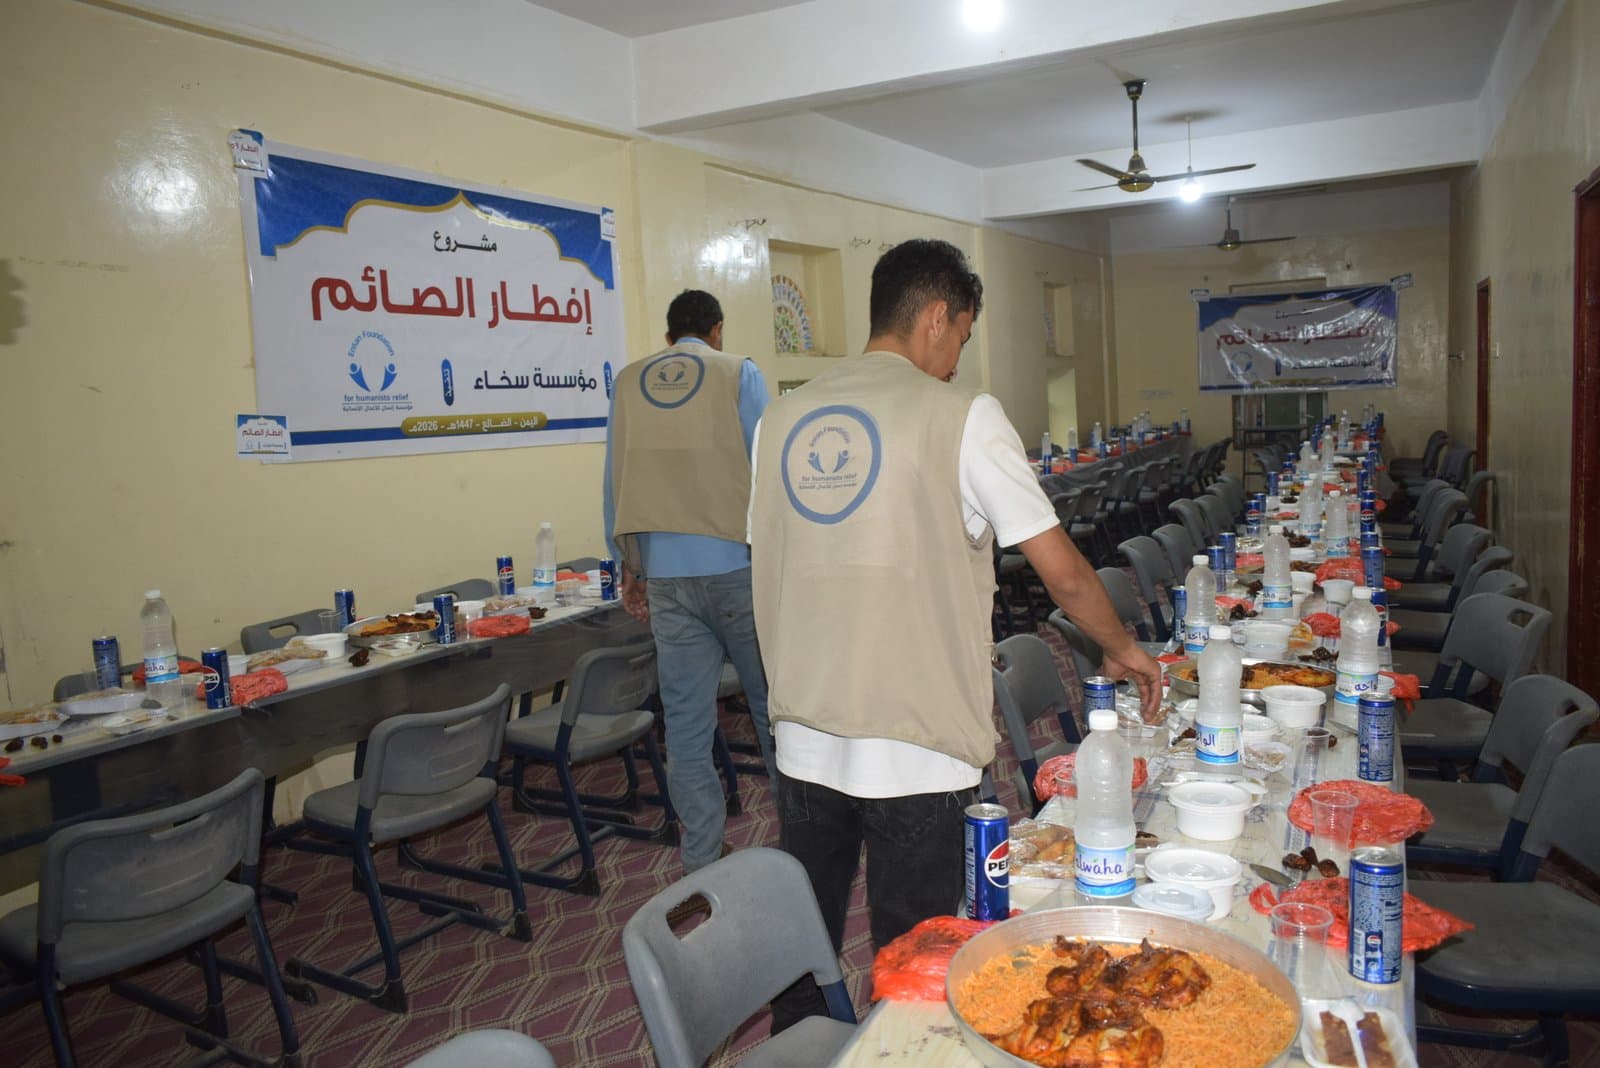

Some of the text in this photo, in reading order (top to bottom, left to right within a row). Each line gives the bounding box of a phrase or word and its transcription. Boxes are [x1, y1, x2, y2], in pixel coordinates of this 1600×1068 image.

[433, 230, 497, 253] مشروع
[311, 266, 592, 335] إفطار الصائم
[474, 369, 529, 390] سخاء
[534, 368, 597, 392] مؤسسة
[481, 418, 512, 432] الضالع
[519, 416, 539, 429] اليمن
